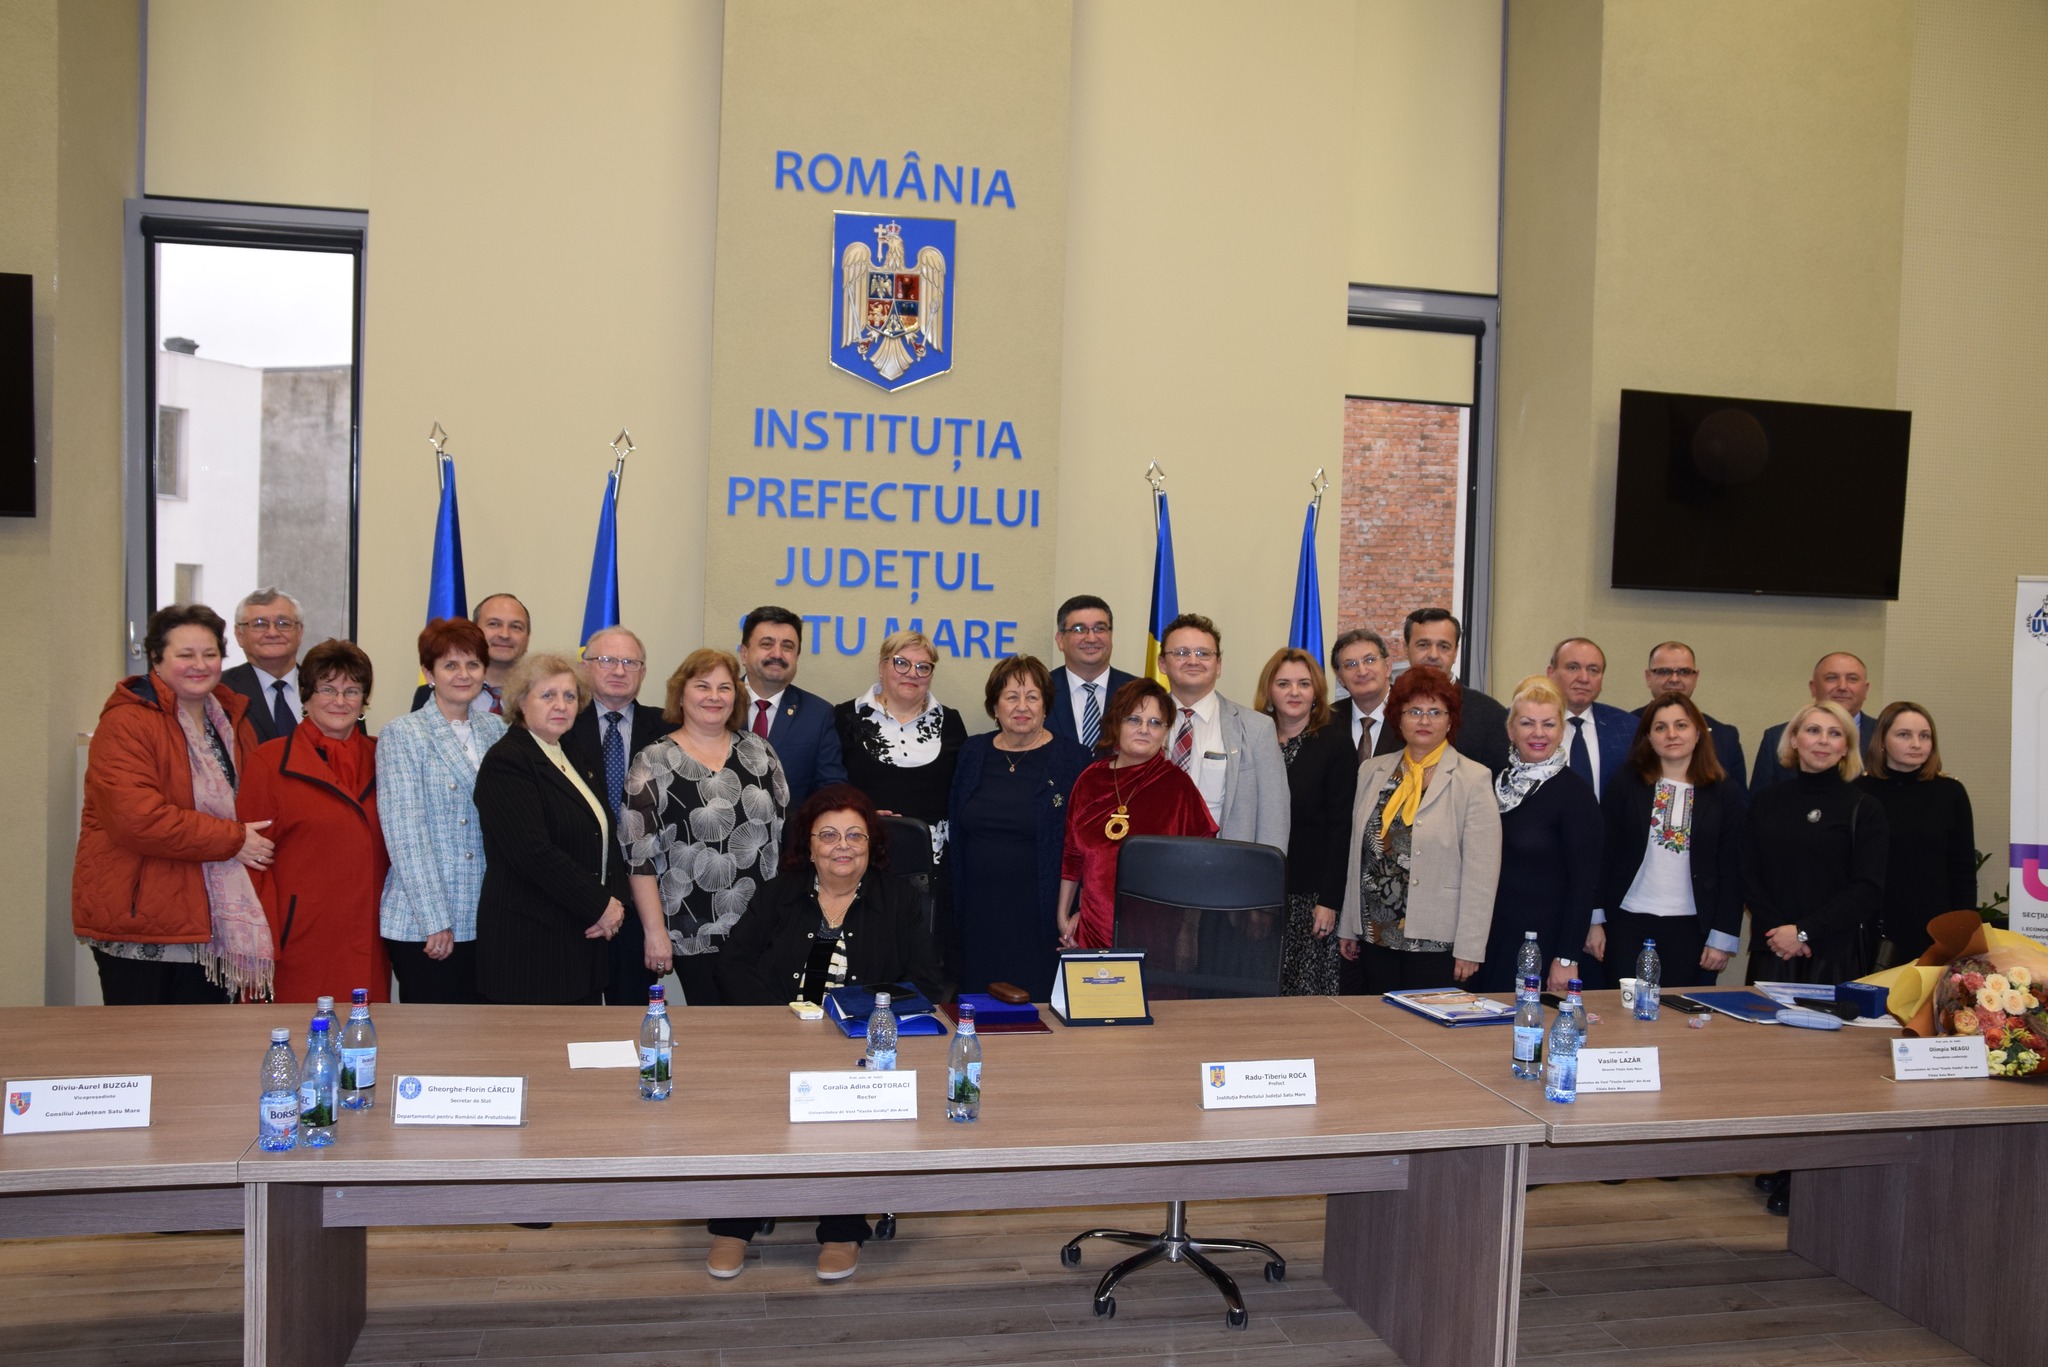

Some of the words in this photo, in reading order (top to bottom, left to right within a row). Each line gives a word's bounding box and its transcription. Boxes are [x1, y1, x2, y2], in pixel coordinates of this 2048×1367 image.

[775, 150, 1016, 209] ROMÂNIA
[753, 407, 1022, 472] INSTITUȚIA
[726, 476, 1040, 528] PREFECTULUI
[775, 546, 994, 604] JUDEȚUL
[52, 1083, 100, 1091] Oliviu-Aurel
[428, 1086, 486, 1094] Gheorghe-Florin
